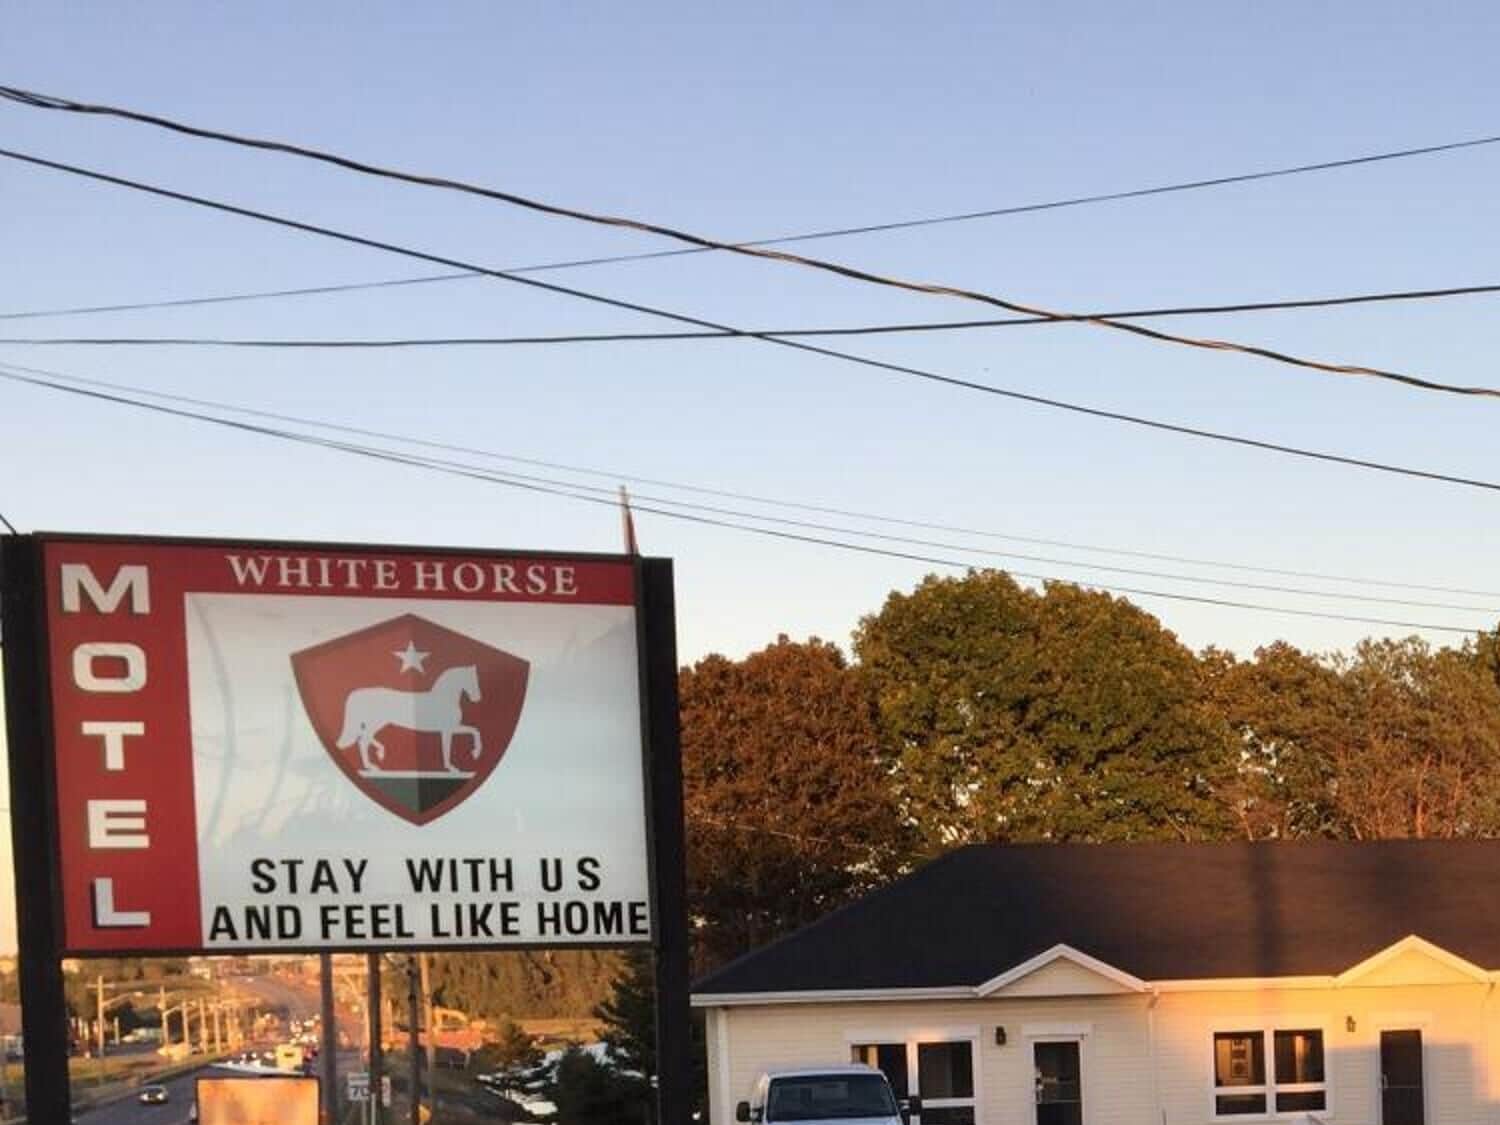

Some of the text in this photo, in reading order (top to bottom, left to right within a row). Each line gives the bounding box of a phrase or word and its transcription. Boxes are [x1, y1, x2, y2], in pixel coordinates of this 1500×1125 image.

[226, 554, 578, 596] WHITE HORSE
[61, 563, 151, 926] MOTEL
[251, 858, 368, 894] STAY
[406, 858, 514, 893] WITH
[209, 900, 649, 941] AND FEEL LIKE HOME
